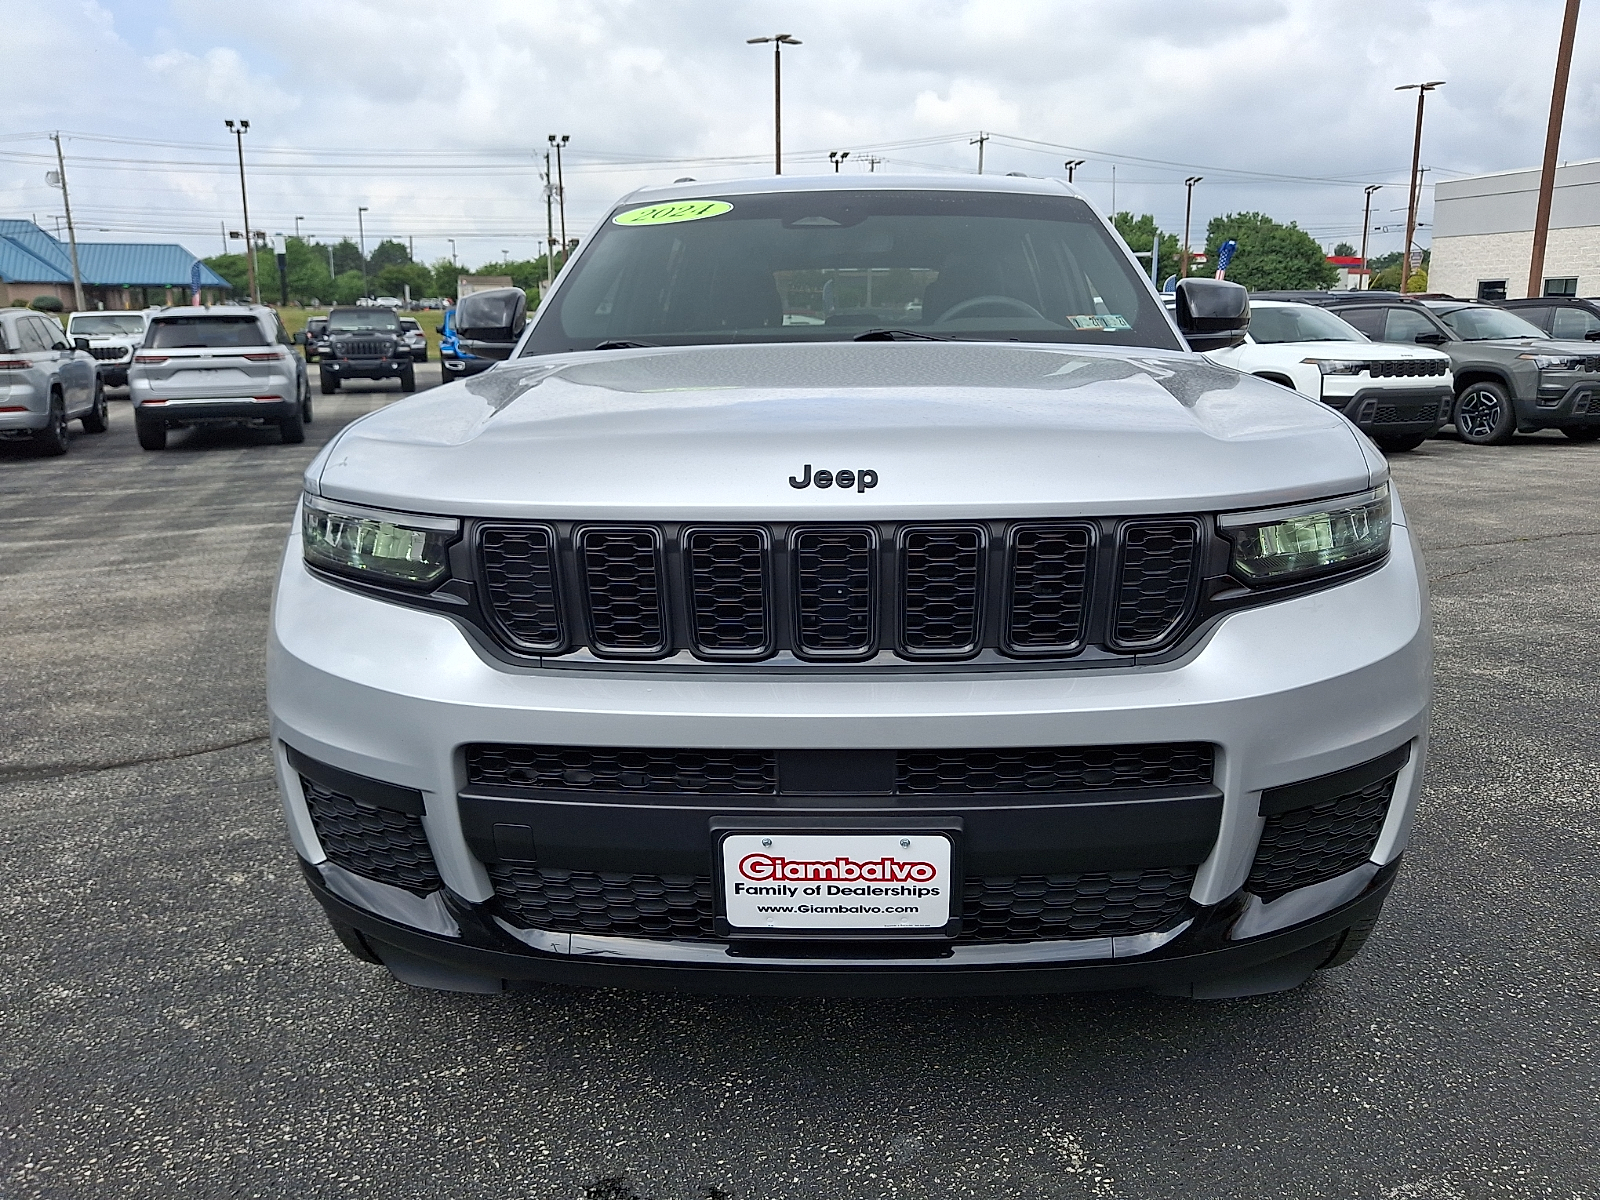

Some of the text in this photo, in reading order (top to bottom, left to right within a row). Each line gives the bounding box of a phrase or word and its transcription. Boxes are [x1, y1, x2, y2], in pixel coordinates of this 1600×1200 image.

[788, 464, 879, 494] Jeep
[738, 853, 937, 883] Giambalvo
[734, 883, 941, 898] Family of Dealerships
[756, 904, 919, 914] www.Giambalvo.com
